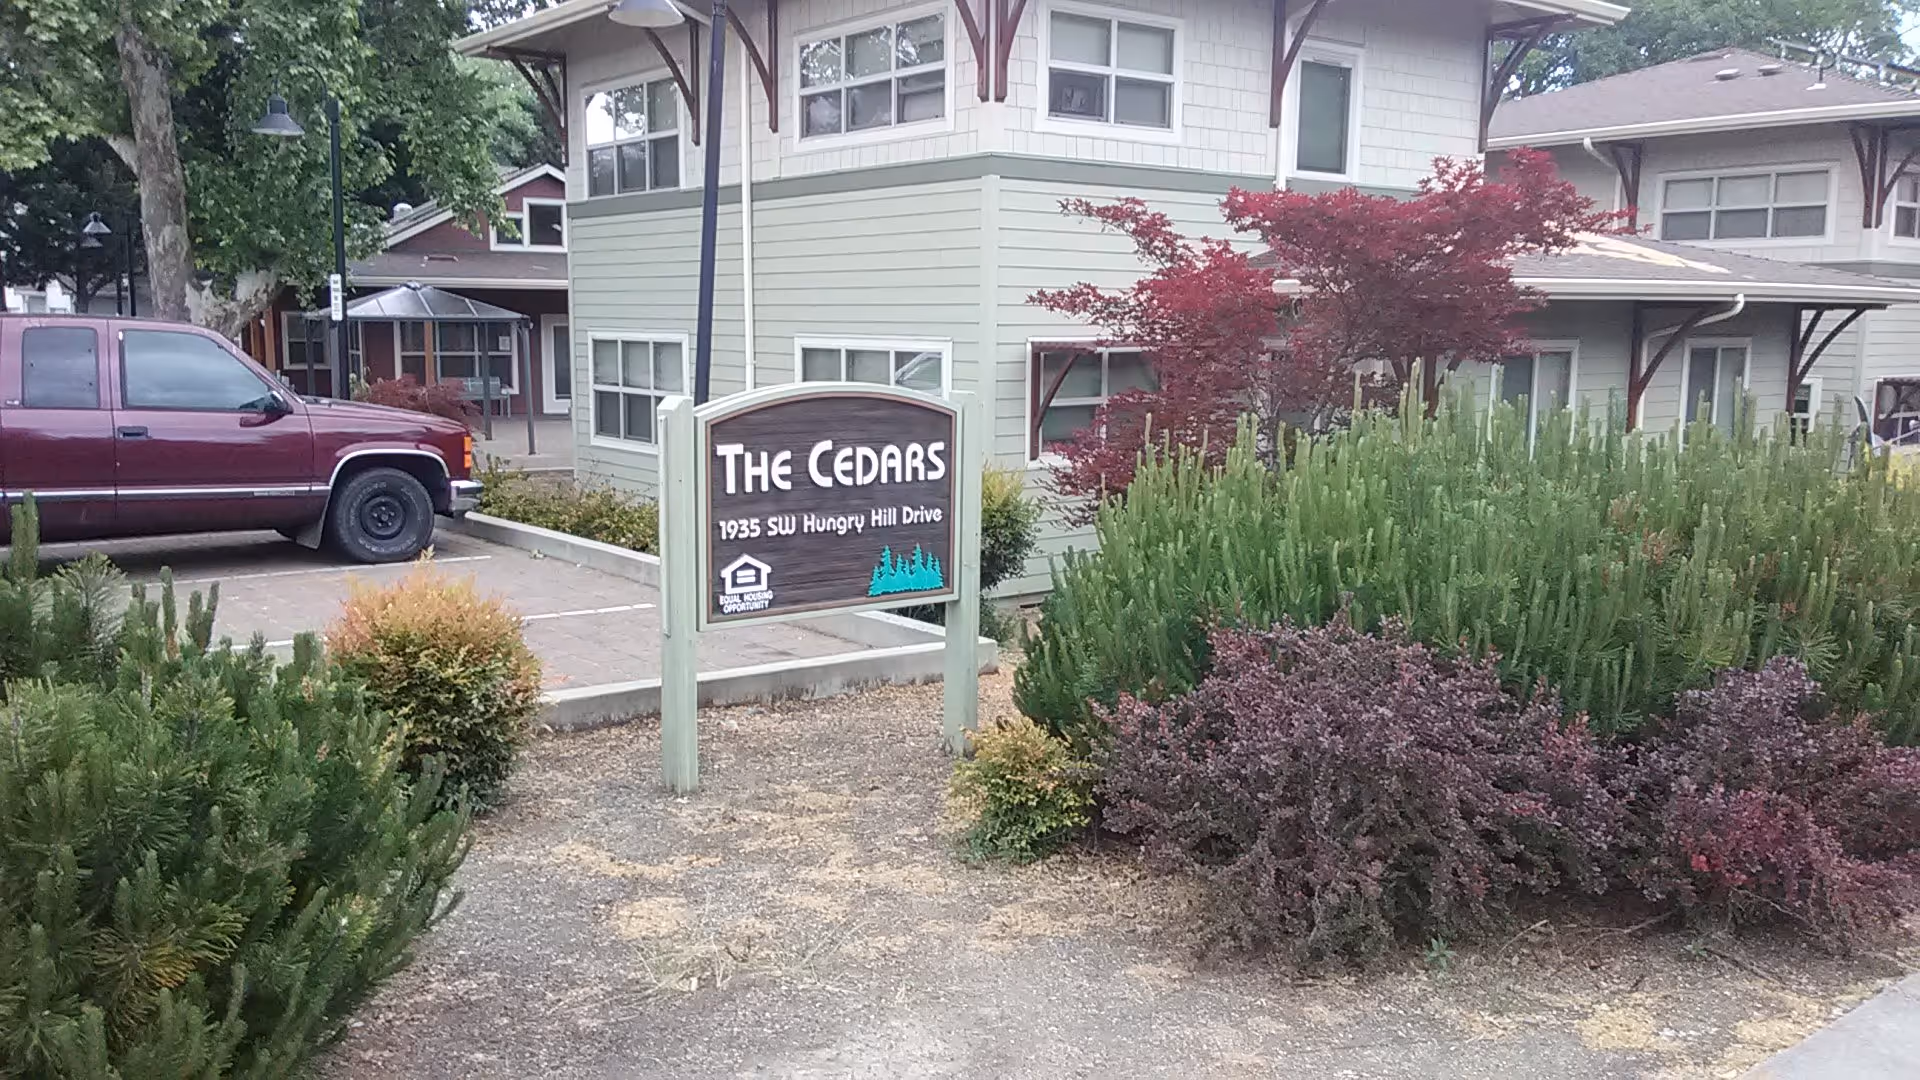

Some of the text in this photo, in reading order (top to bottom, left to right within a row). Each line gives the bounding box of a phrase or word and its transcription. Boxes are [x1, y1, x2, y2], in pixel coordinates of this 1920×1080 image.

[716, 439, 946, 494] THE CEDARS
[719, 505, 943, 540] 1935 SW Hungry Hill Drive
[719, 590, 774, 606] EQUAL HOUSING
[723, 600, 769, 614] OPPORTUNITY
